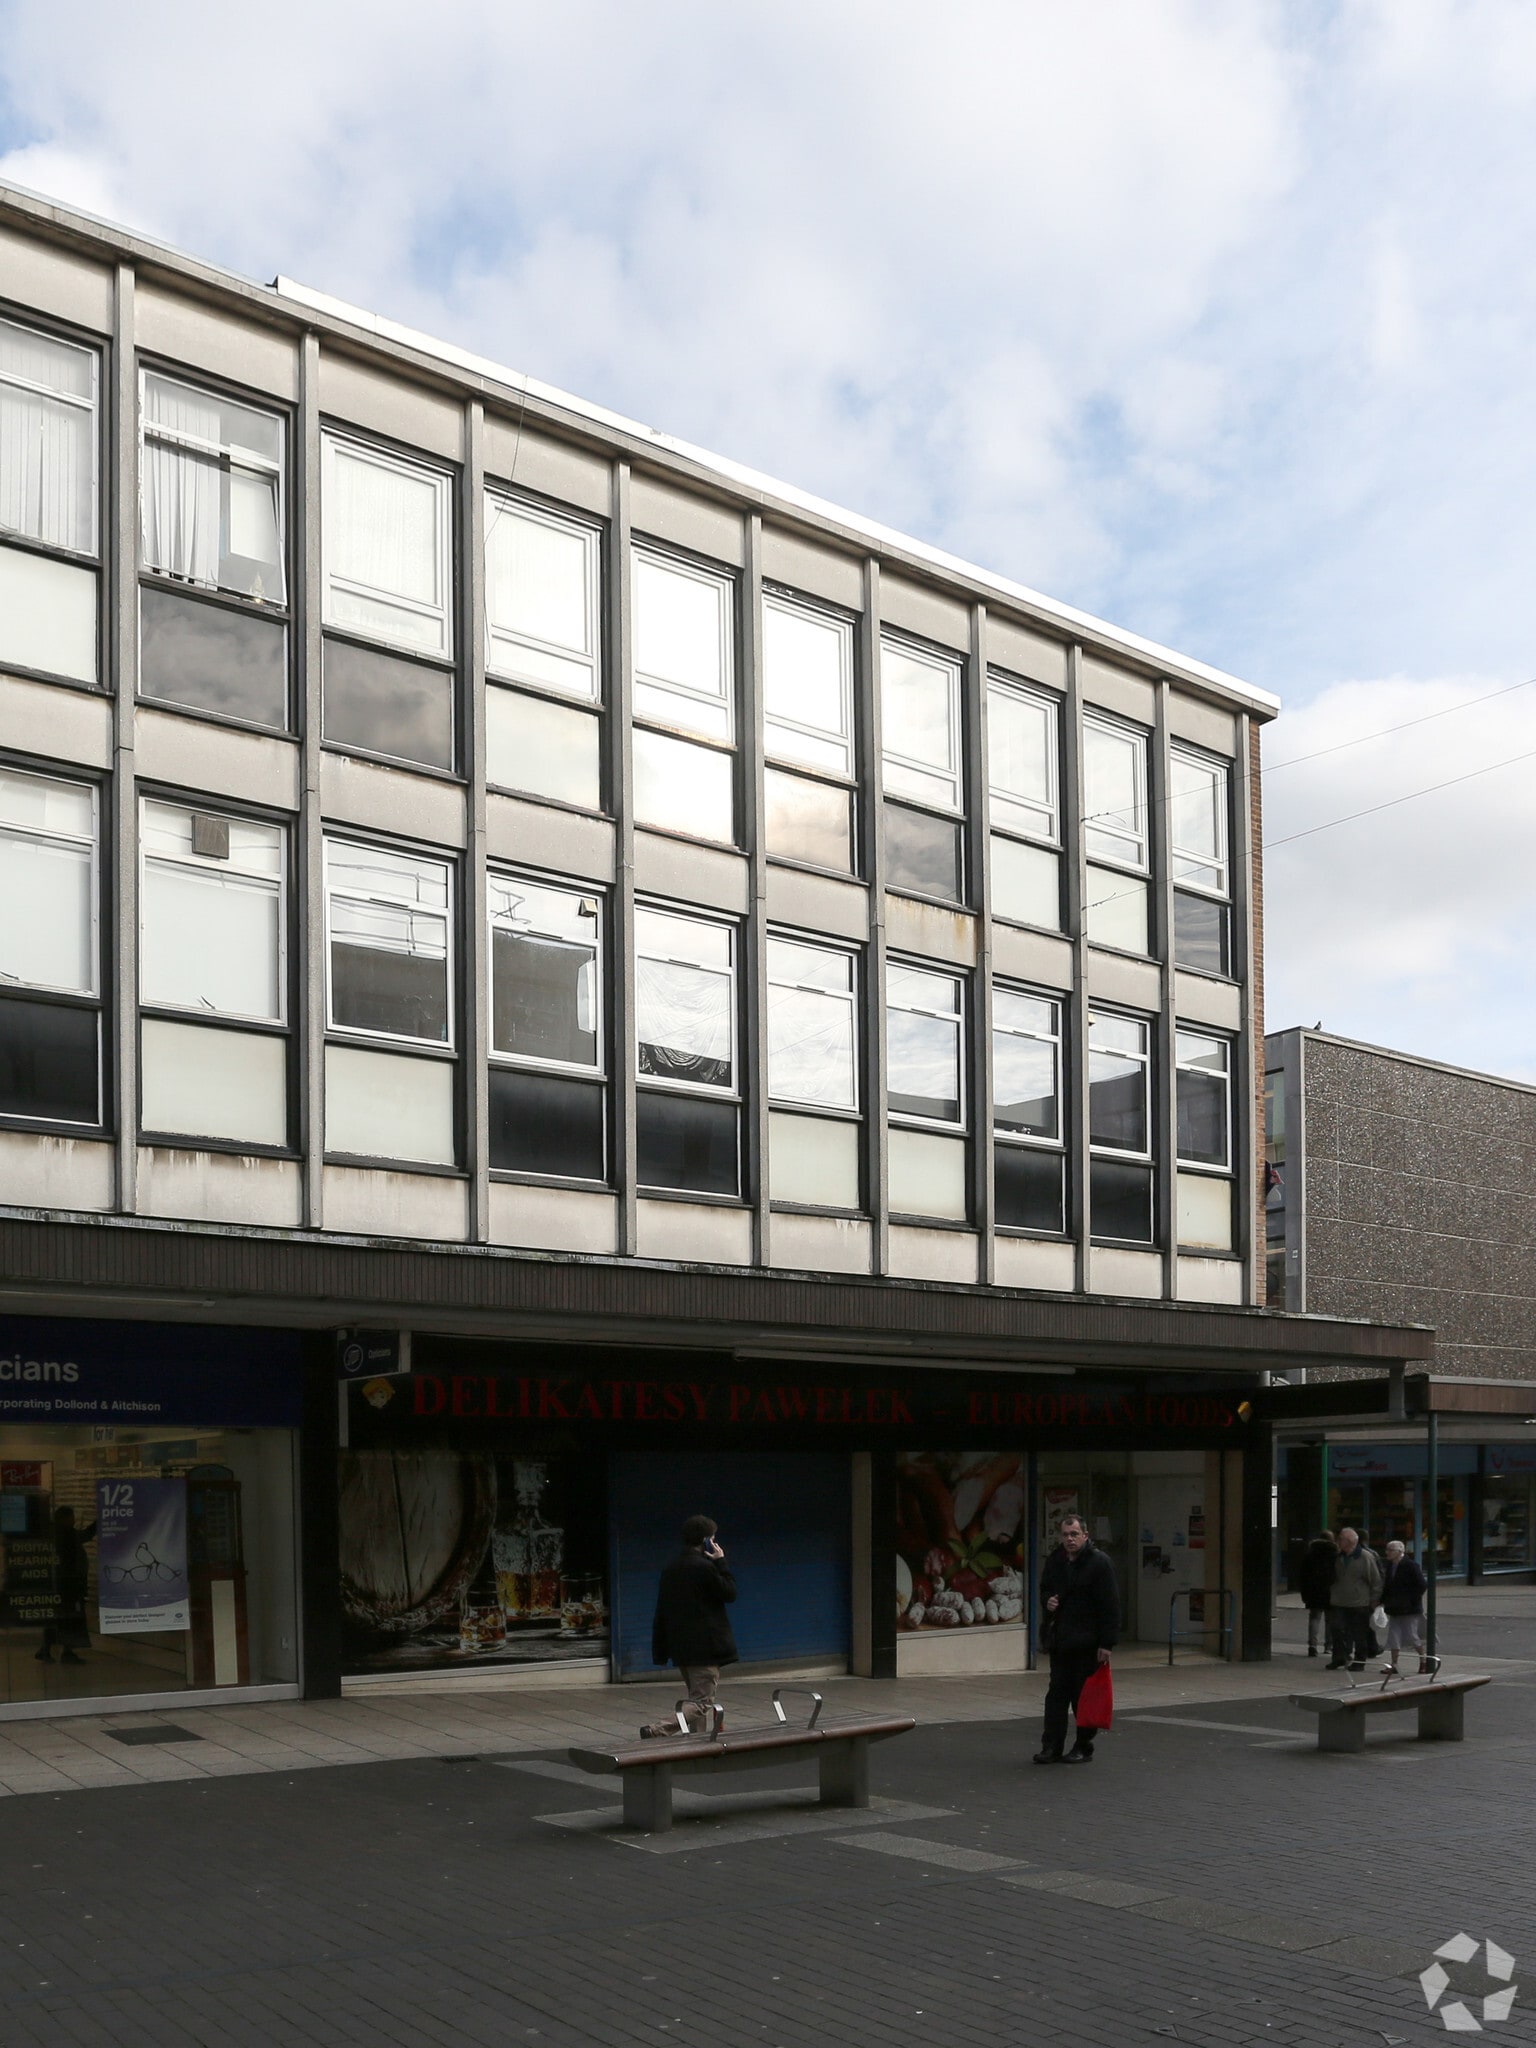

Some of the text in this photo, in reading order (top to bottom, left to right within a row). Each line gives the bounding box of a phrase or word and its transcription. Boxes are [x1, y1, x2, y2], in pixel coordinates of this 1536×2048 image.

[0, 1353, 80, 1383] cians
[55, 1399, 97, 1410] Dollond
[100, 1400, 109, 1410] &
[111, 1400, 161, 1411] Aitchison
[412, 1374, 711, 1422] DELIKATESY
[968, 1391, 1135, 1425] EUROPEAN
[100, 1484, 134, 1506] 1/2
[102, 1506, 134, 1519] price
[12, 1543, 56, 1553] DIGITAL
[8, 1555, 61, 1566] HEARING
[21, 1569, 49, 1579] AIDS
[9, 1594, 62, 1606] HEARING
[18, 1608, 55, 1619] TESTS
